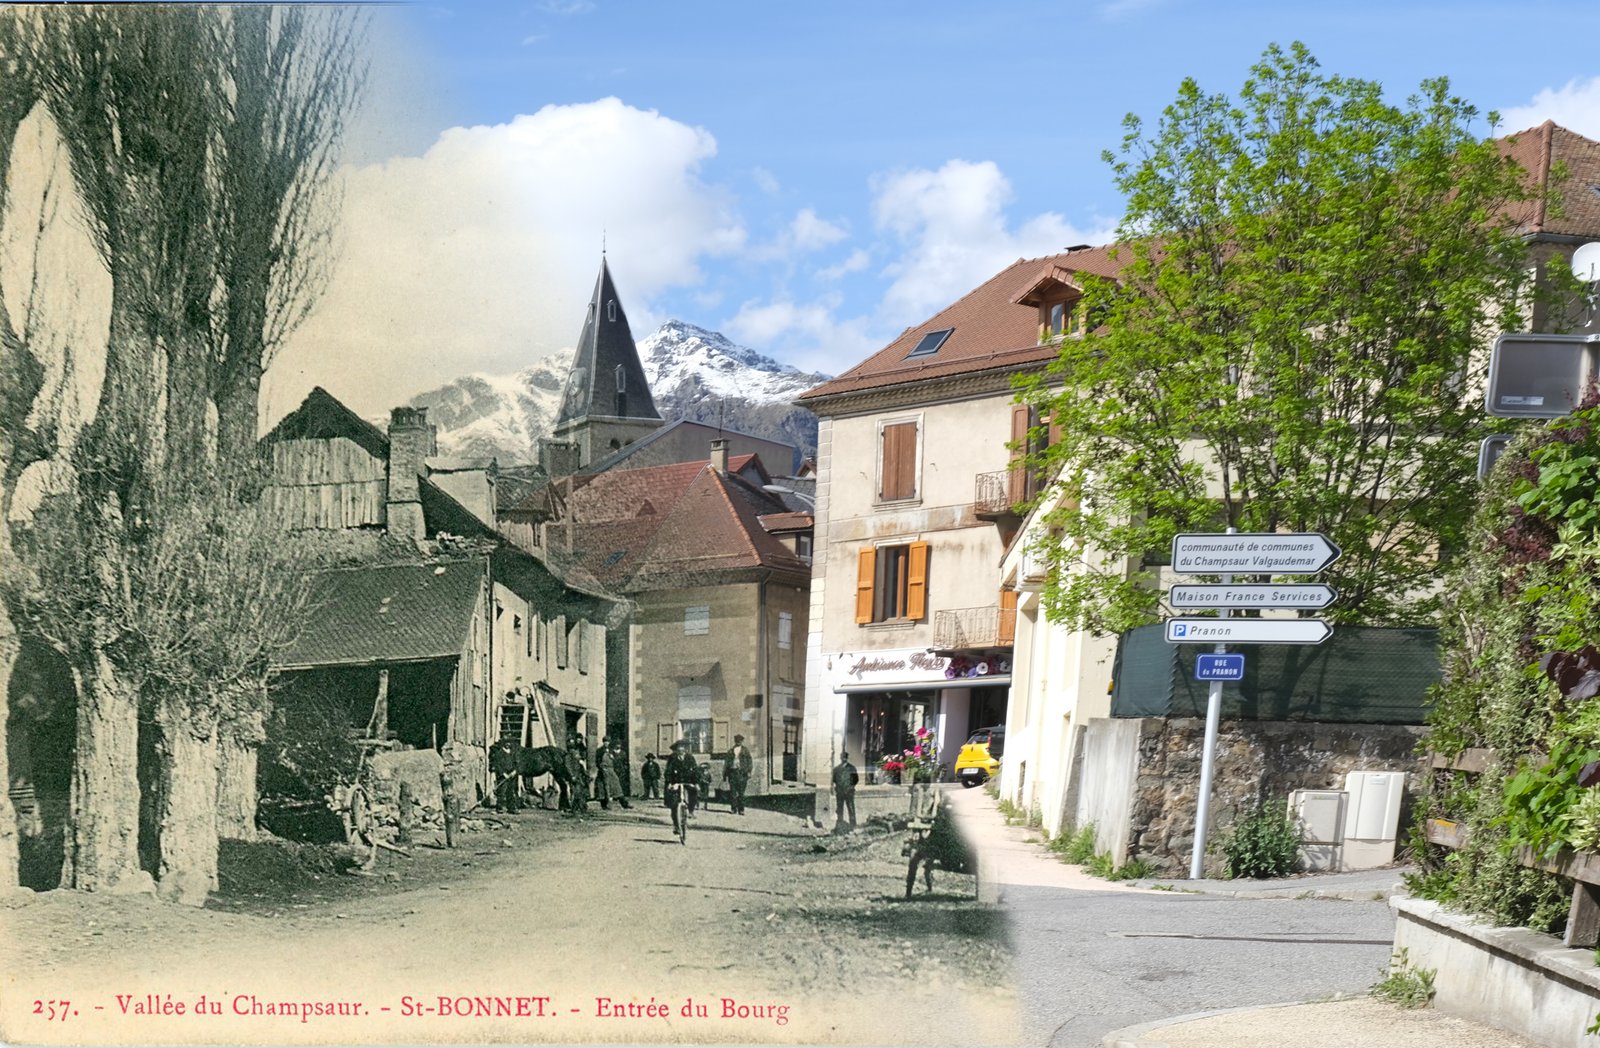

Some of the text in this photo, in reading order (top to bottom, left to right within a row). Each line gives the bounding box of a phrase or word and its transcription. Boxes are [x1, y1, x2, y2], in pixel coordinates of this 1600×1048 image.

[1181, 541, 1314, 552] communauté de communes
[1180, 556, 1315, 568] du Champsaur Valgaudemar
[1177, 591, 1323, 601] Maison France Services
[1190, 626, 1232, 635] Pranon
[1214, 659, 1227, 667] RUE
